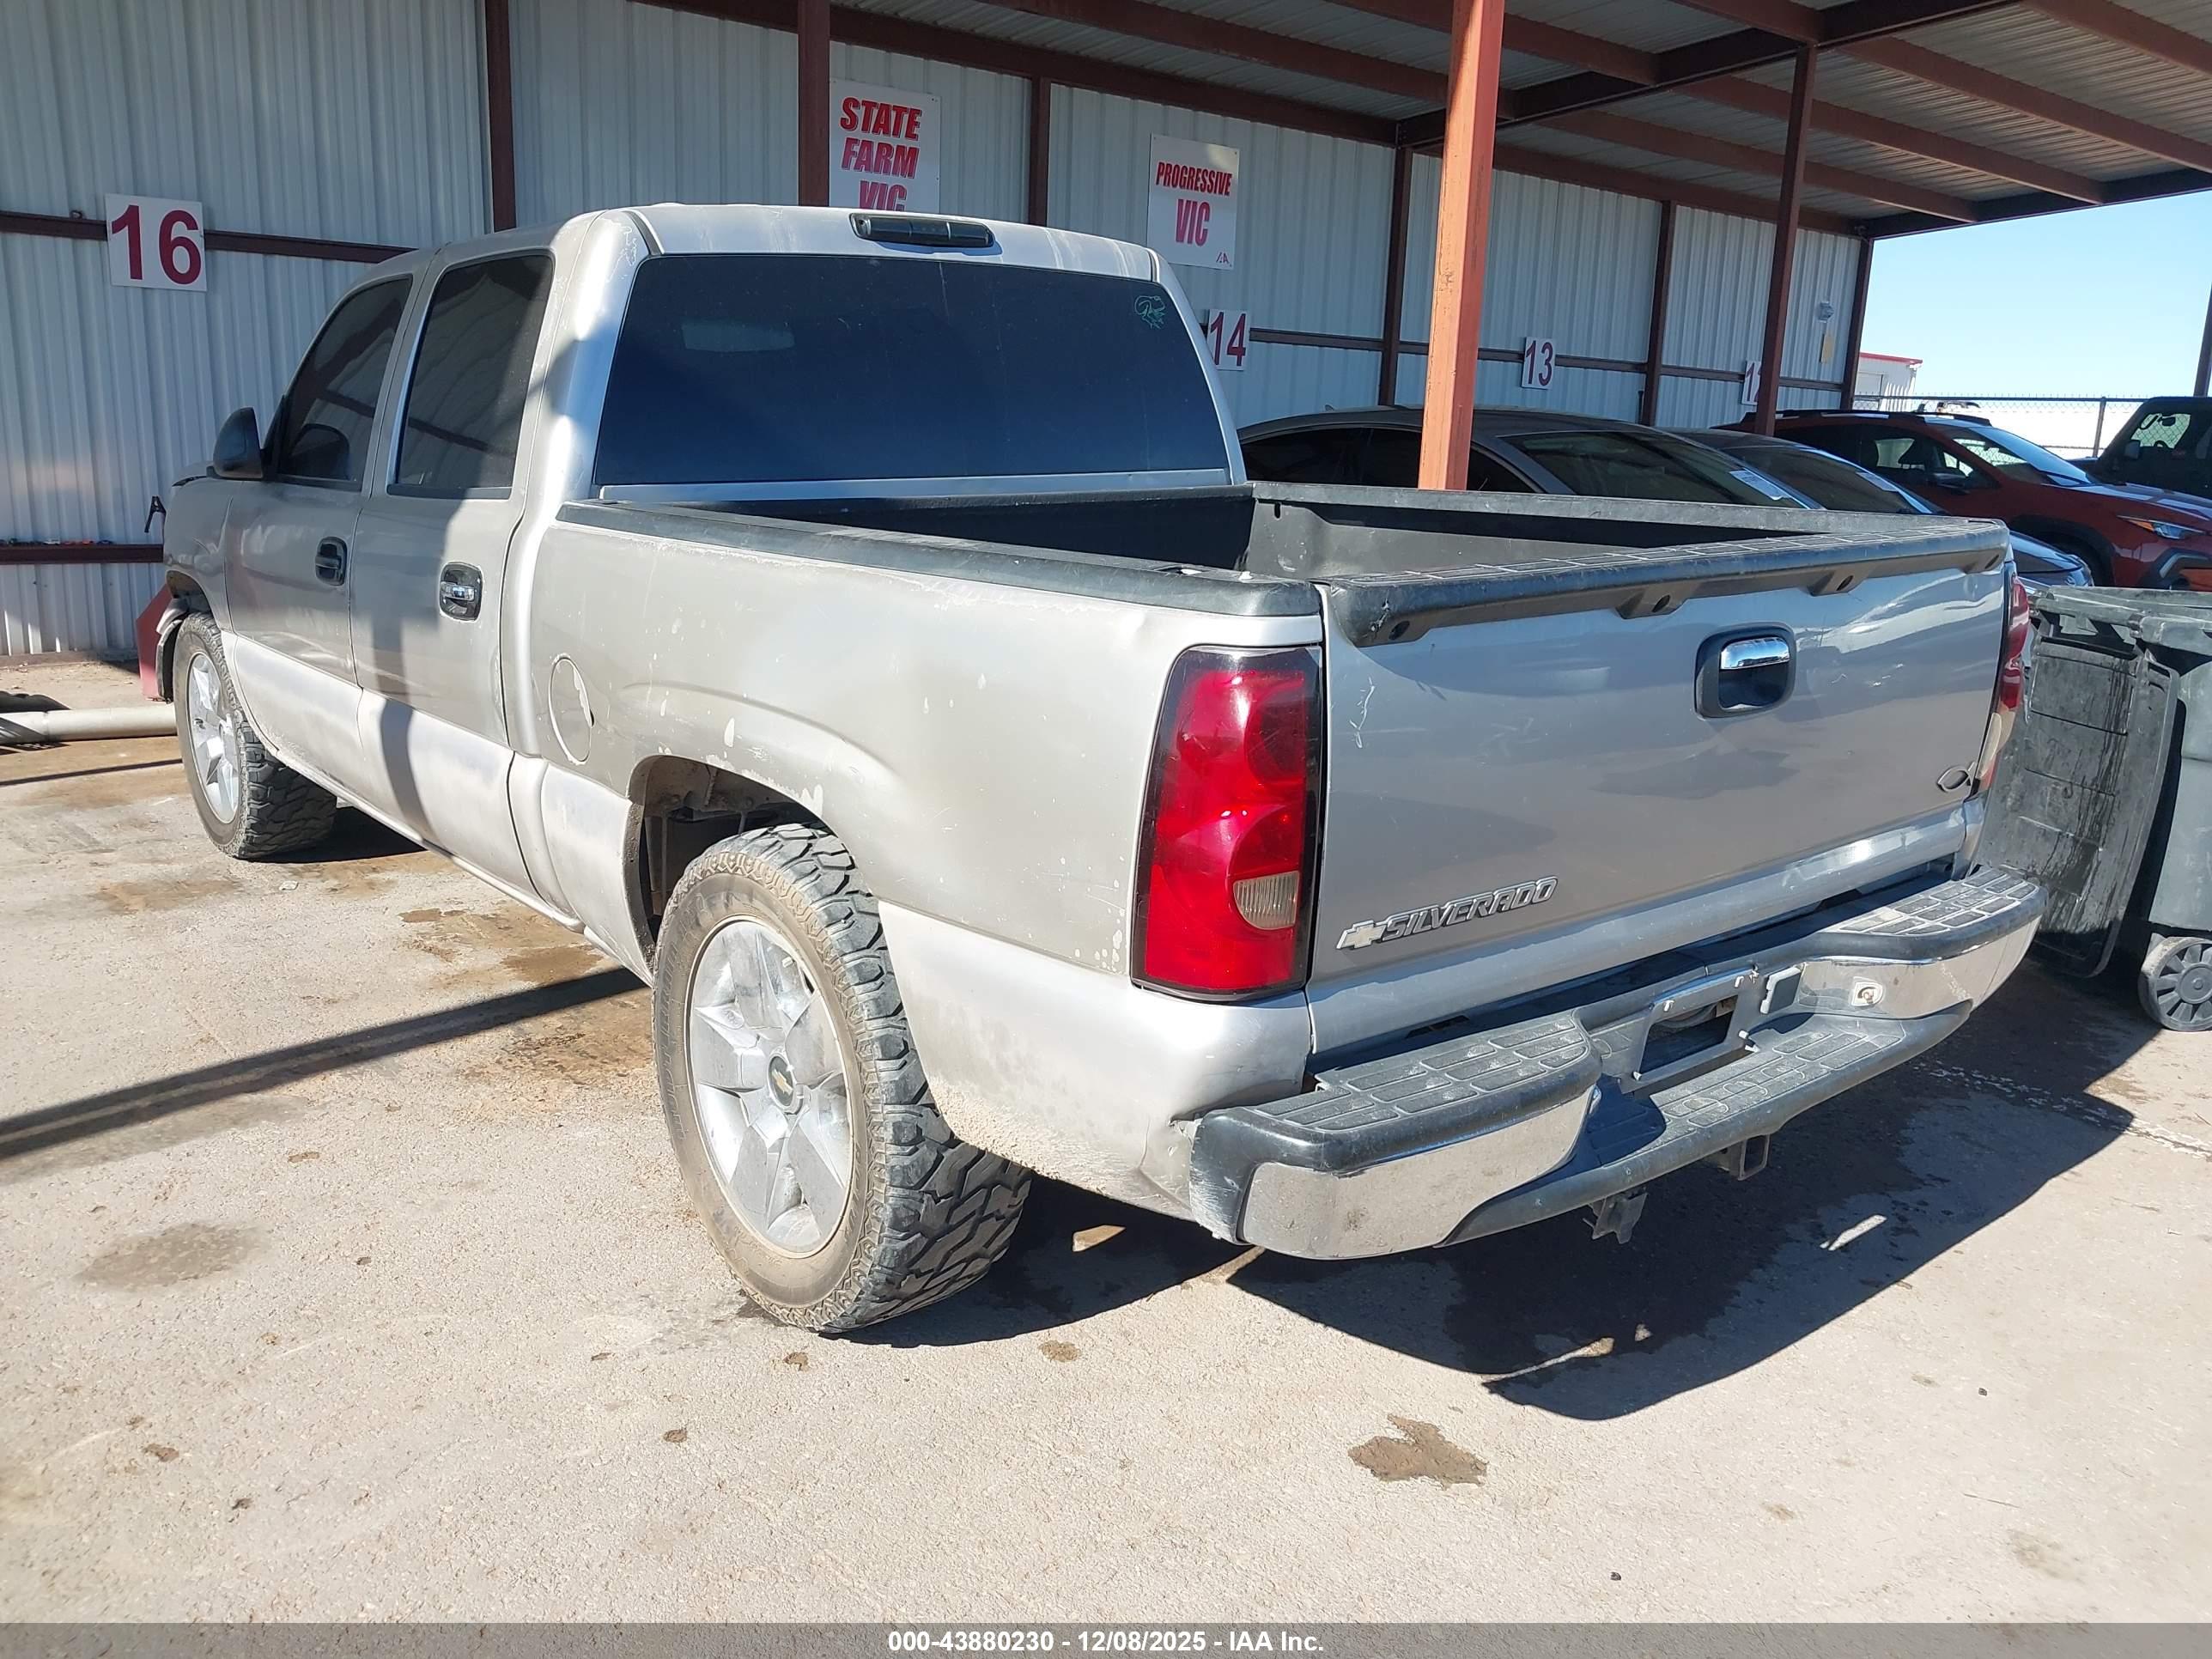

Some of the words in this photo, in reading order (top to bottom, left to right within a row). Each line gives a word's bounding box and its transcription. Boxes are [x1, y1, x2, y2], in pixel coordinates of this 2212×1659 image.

[841, 97, 922, 141] STATE
[842, 137, 920, 179] FARM
[1156, 161, 1233, 197] PROGRESSIVE
[859, 180, 907, 211] VIC
[112, 204, 202, 285] 16
[1176, 198, 1211, 246] VIC
[1210, 311, 1246, 367] 14
[1526, 340, 1553, 386] 13
[1382, 876, 1558, 941] SILVERADO
